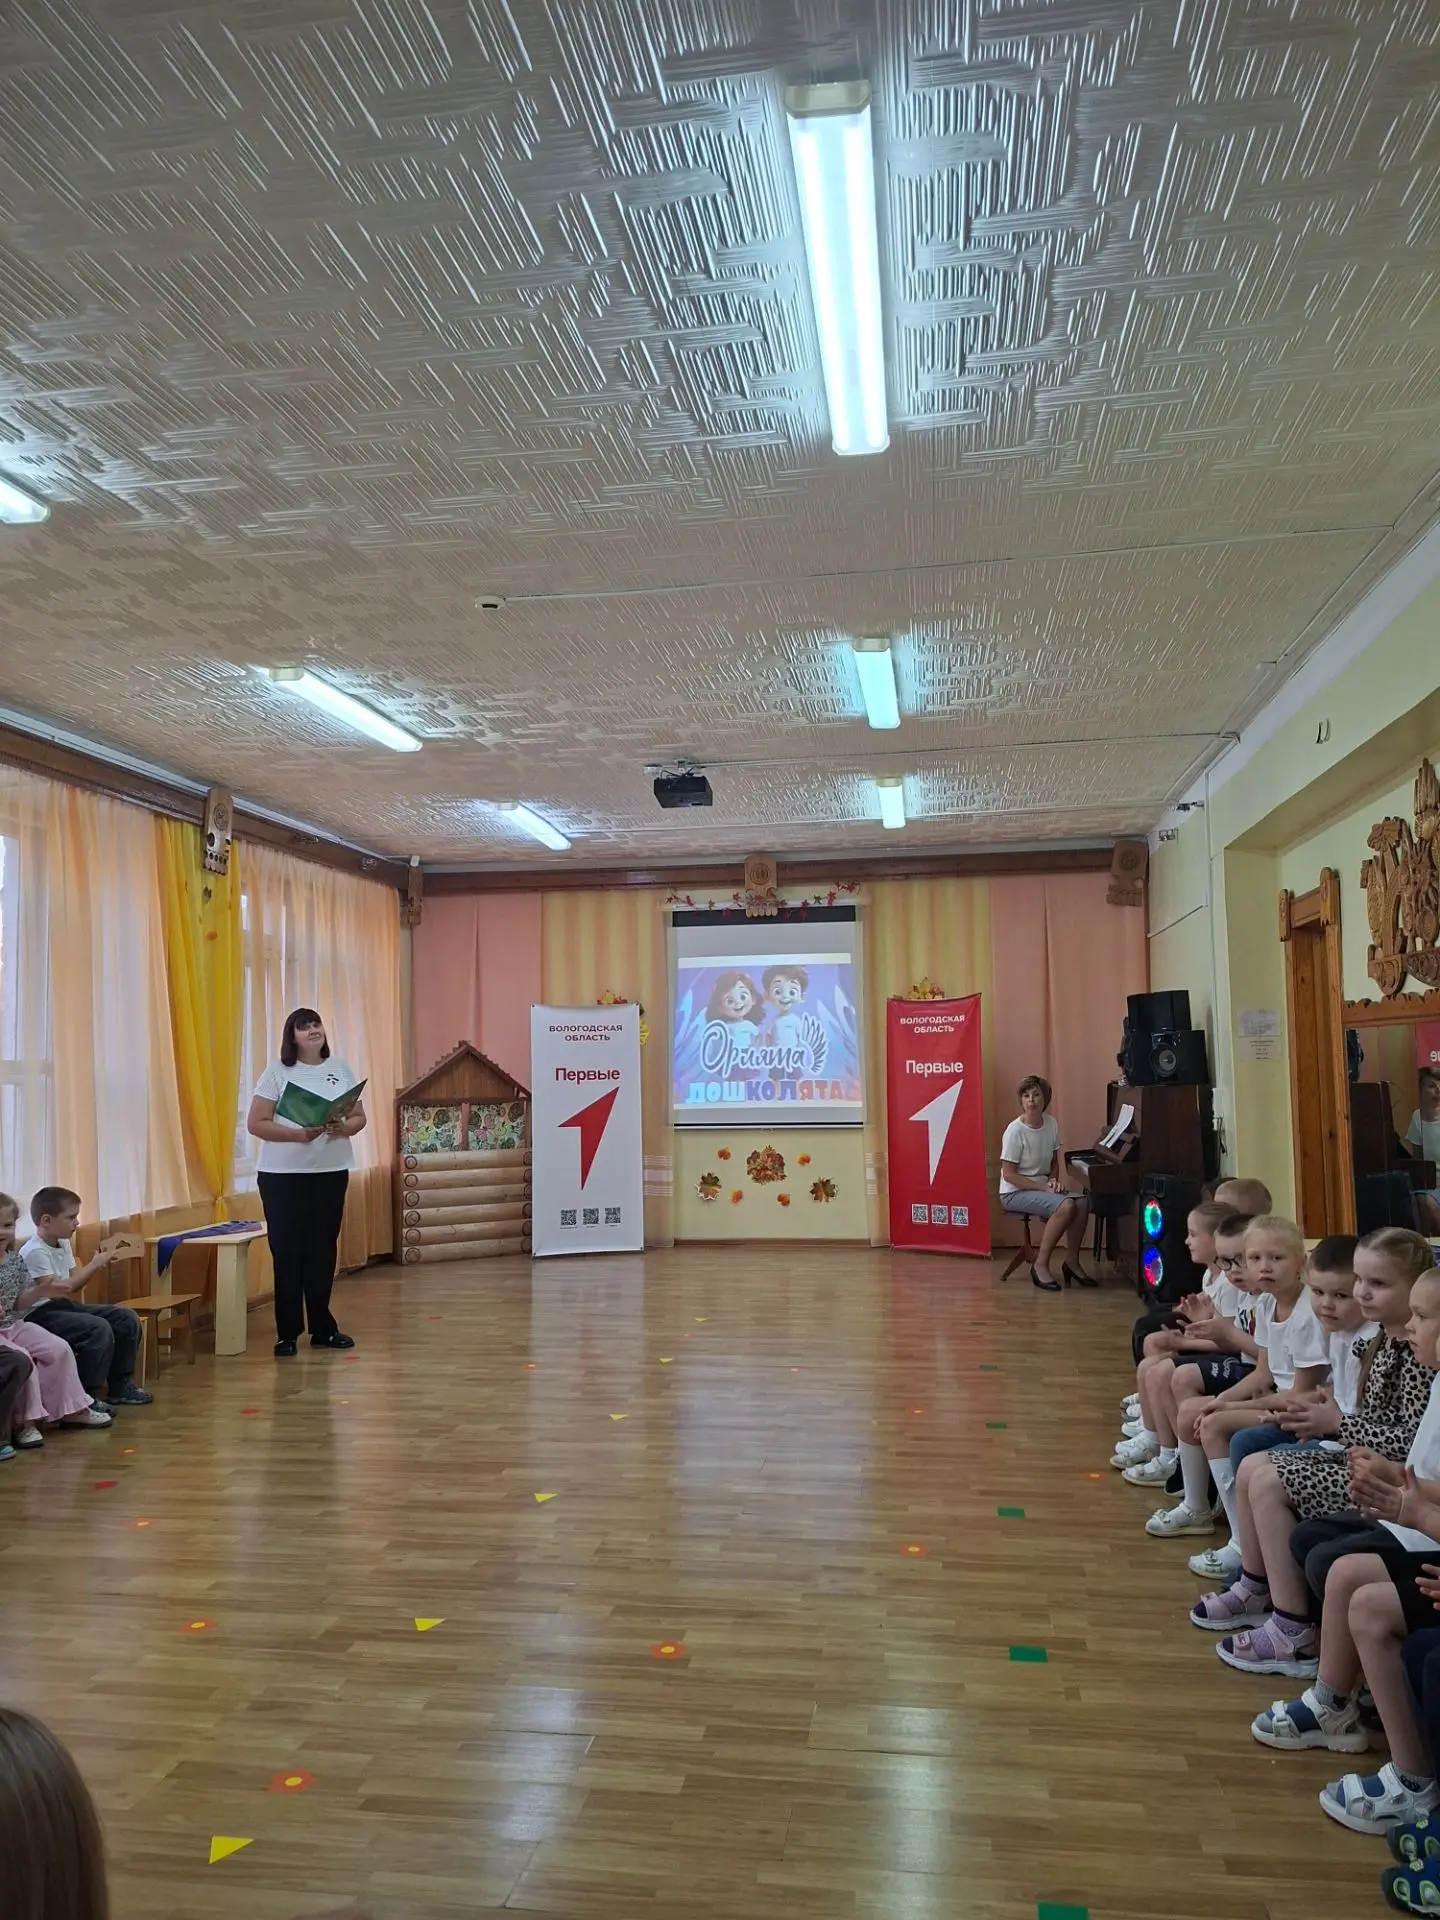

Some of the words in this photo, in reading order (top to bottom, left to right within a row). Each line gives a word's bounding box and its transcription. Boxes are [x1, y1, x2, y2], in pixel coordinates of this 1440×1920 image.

[900, 1015, 965, 1025] ВОЛОГОДСКАЯ
[564, 1034, 611, 1042] ОБЛАСТЬ
[914, 1025, 955, 1034] ОБЛАСТЬ
[702, 1021, 806, 1078] Орлята
[555, 1067, 621, 1085] Первые
[906, 1060, 964, 1078] Первые
[687, 1079, 845, 1104] ДОШКОЛЯТА
